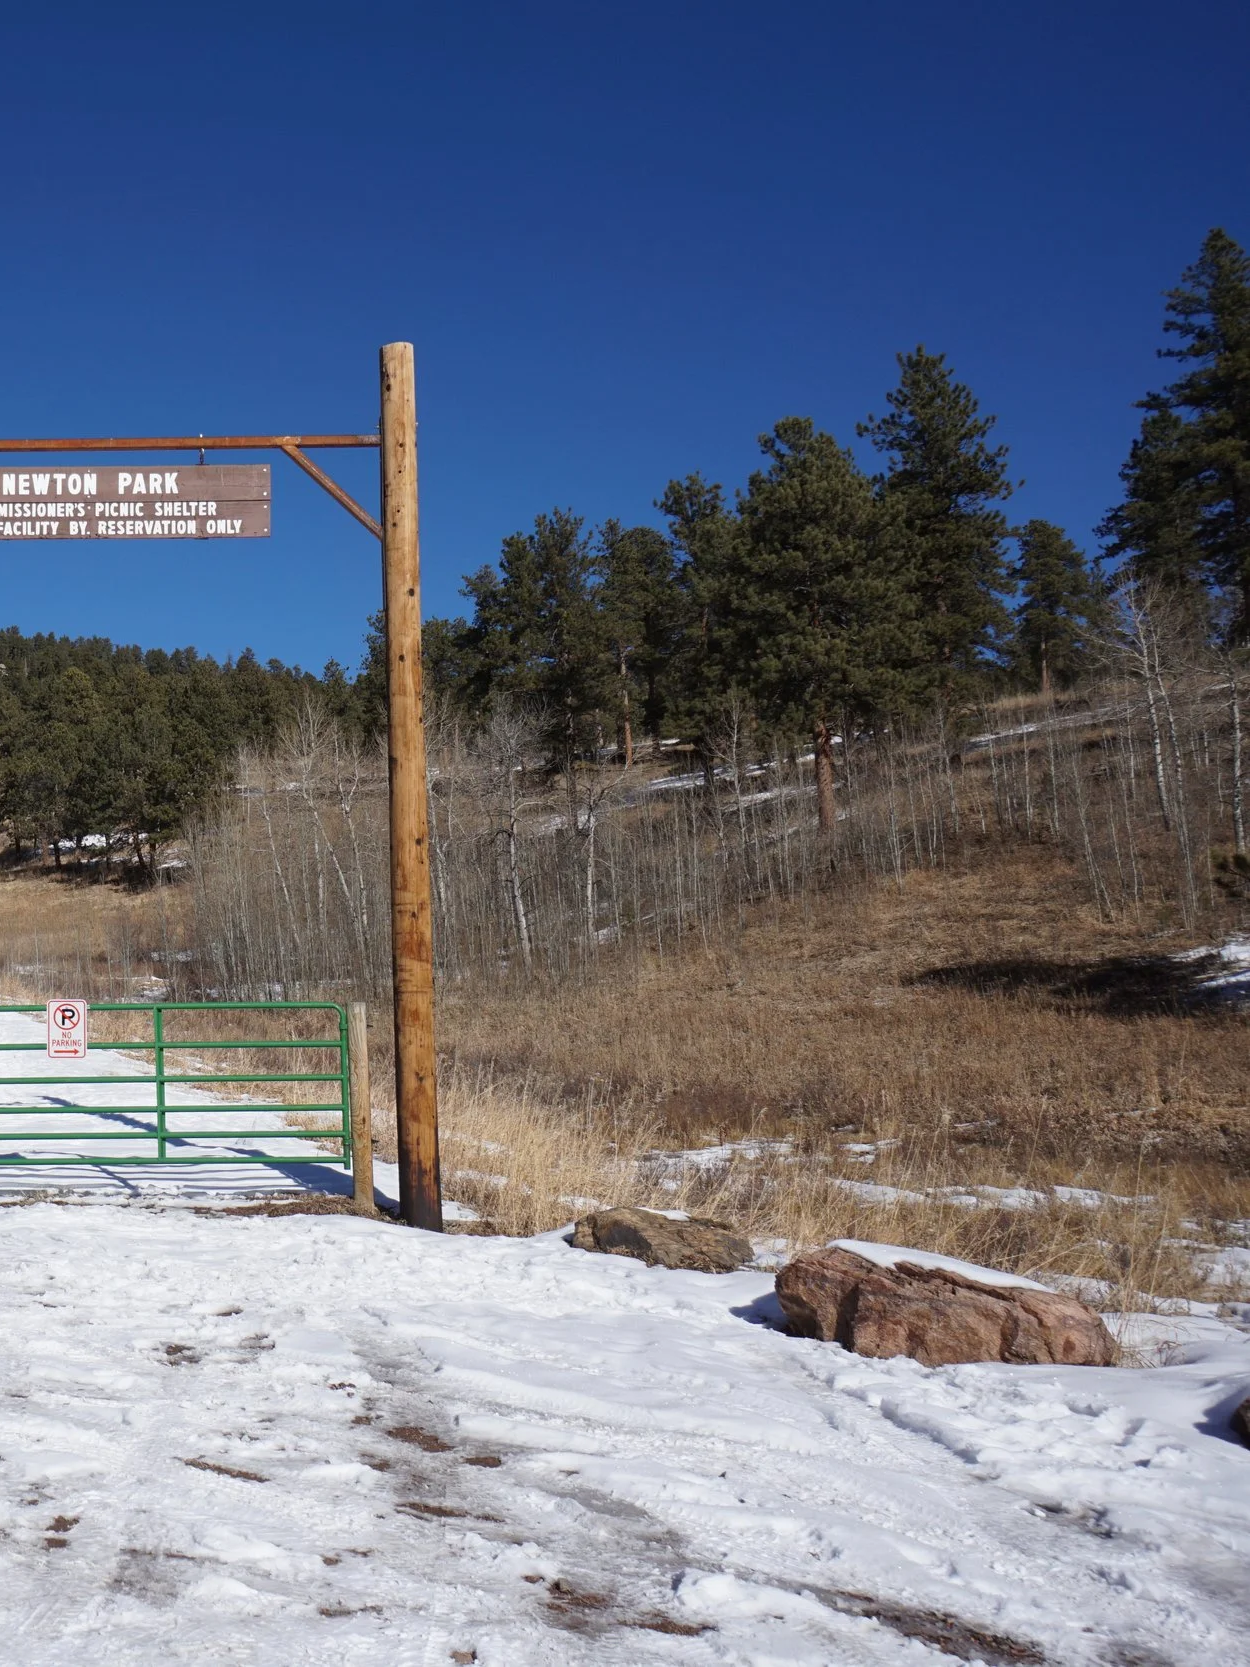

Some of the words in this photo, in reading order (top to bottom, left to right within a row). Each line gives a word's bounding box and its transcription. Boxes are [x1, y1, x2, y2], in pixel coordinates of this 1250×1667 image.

[2, 473, 97, 495] NEWTON
[118, 471, 179, 495] PARK
[95, 502, 144, 517] PICNIC
[155, 501, 217, 517] SHELTER
[98, 520, 196, 535] RESERVATION
[206, 519, 242, 534] ONLY
